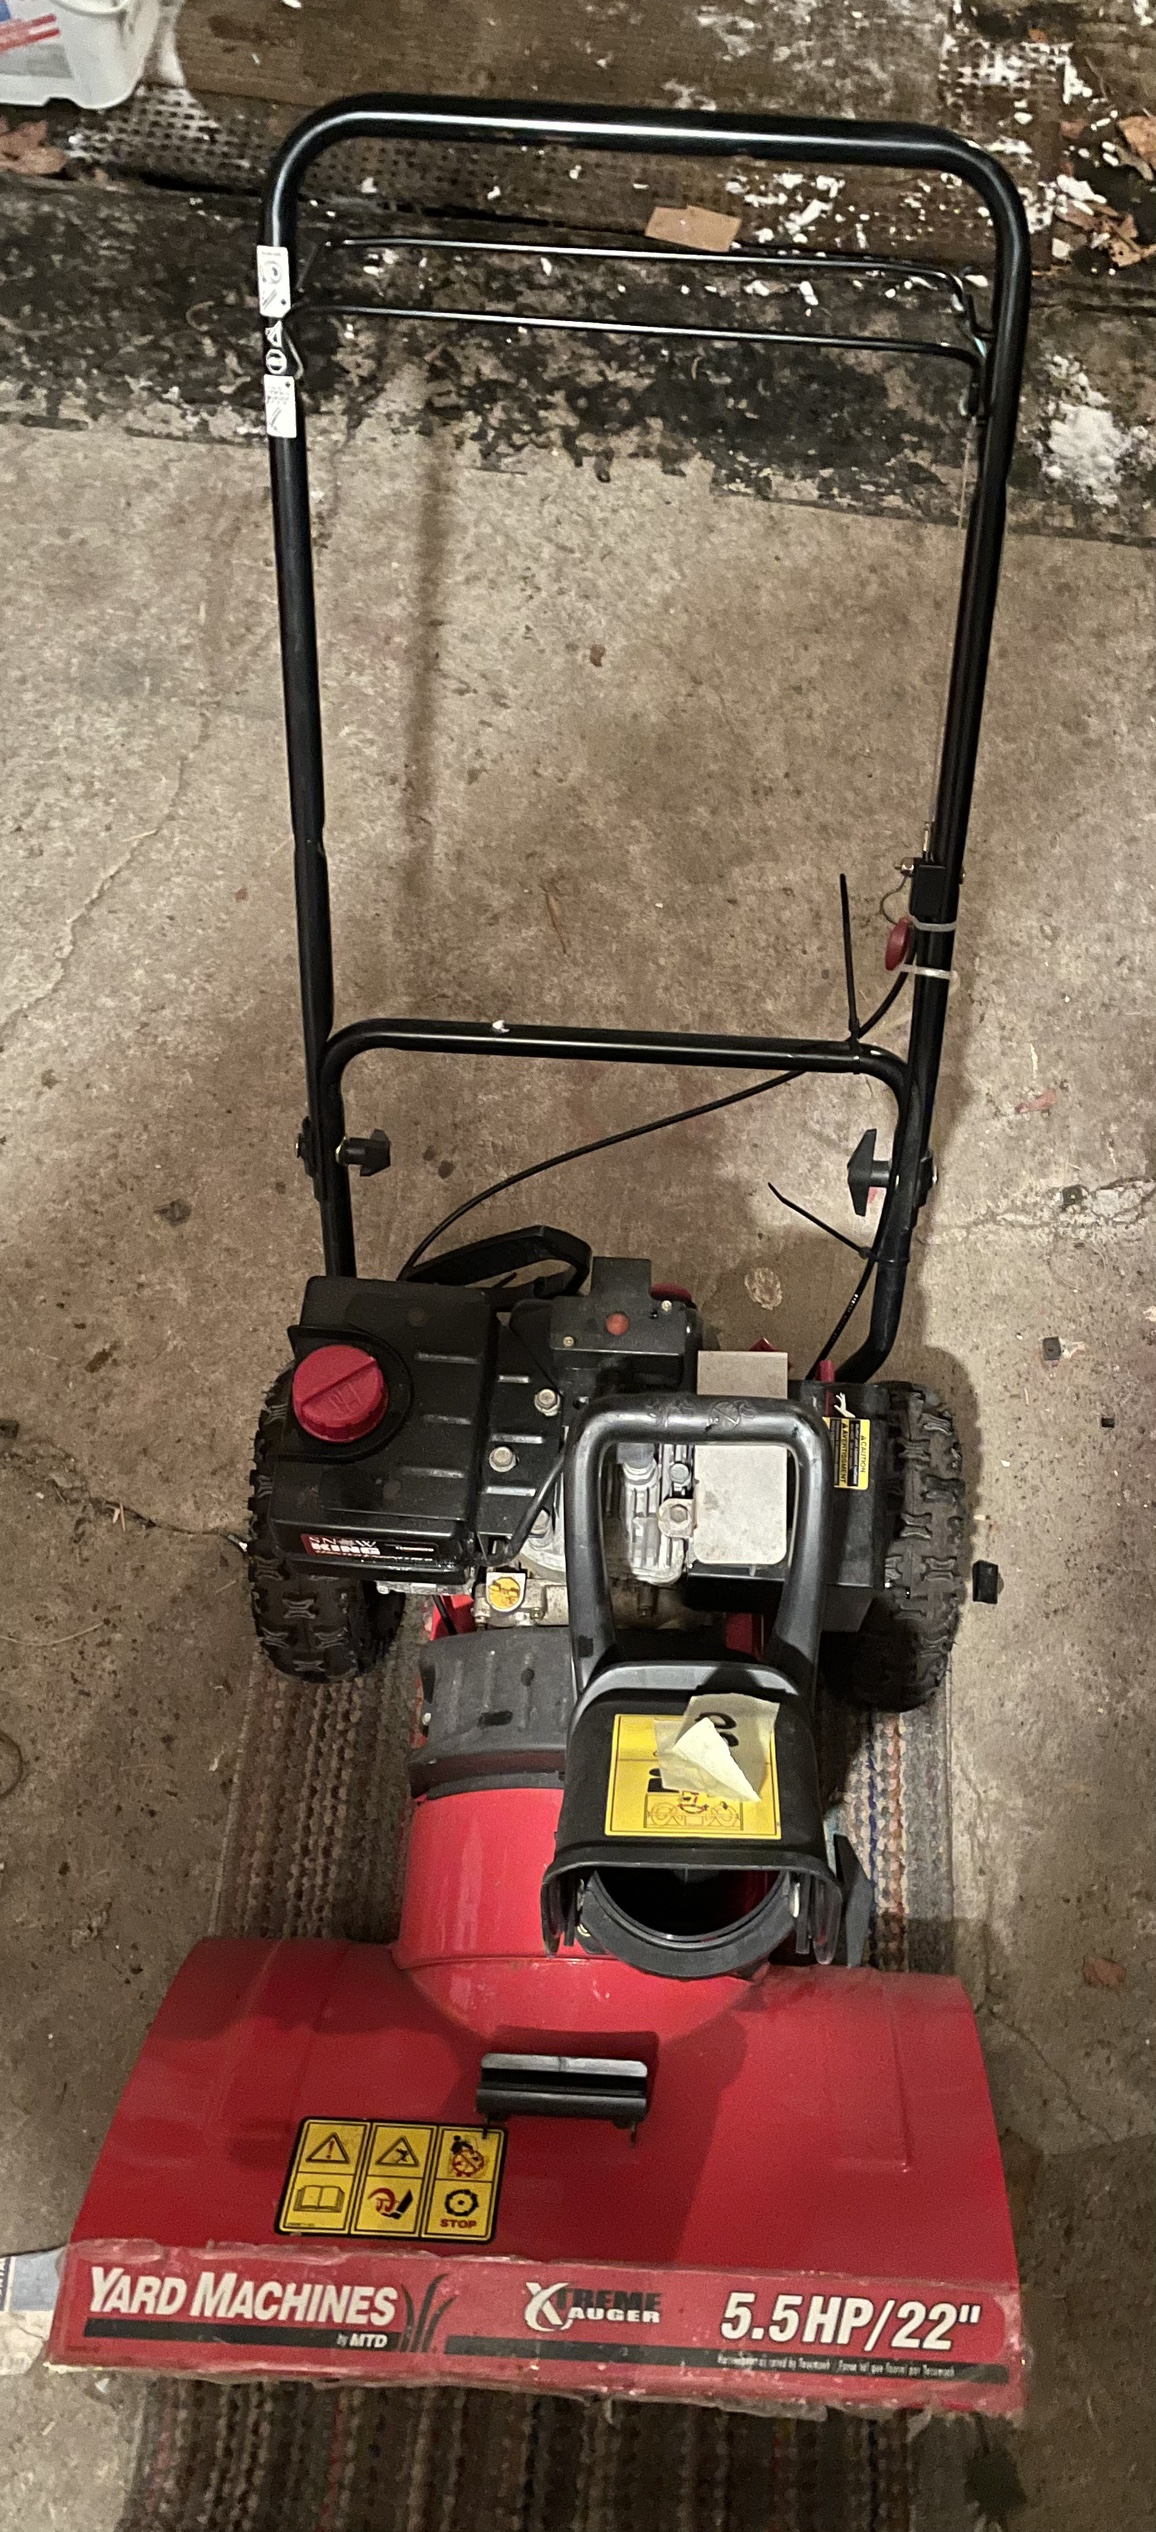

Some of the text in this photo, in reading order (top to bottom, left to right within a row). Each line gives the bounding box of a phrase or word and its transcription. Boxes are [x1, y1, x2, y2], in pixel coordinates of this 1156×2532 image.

[311, 1542, 381, 1556] KING
[440, 2218, 477, 2229] STOP
[89, 2267, 398, 2326] YARD MACHINES
[524, 2282, 662, 2332] XTREME
[568, 2307, 660, 2323] AUGER
[721, 2292, 981, 2351] 5.5HP/22"
[350, 2333, 388, 2348] MTD
